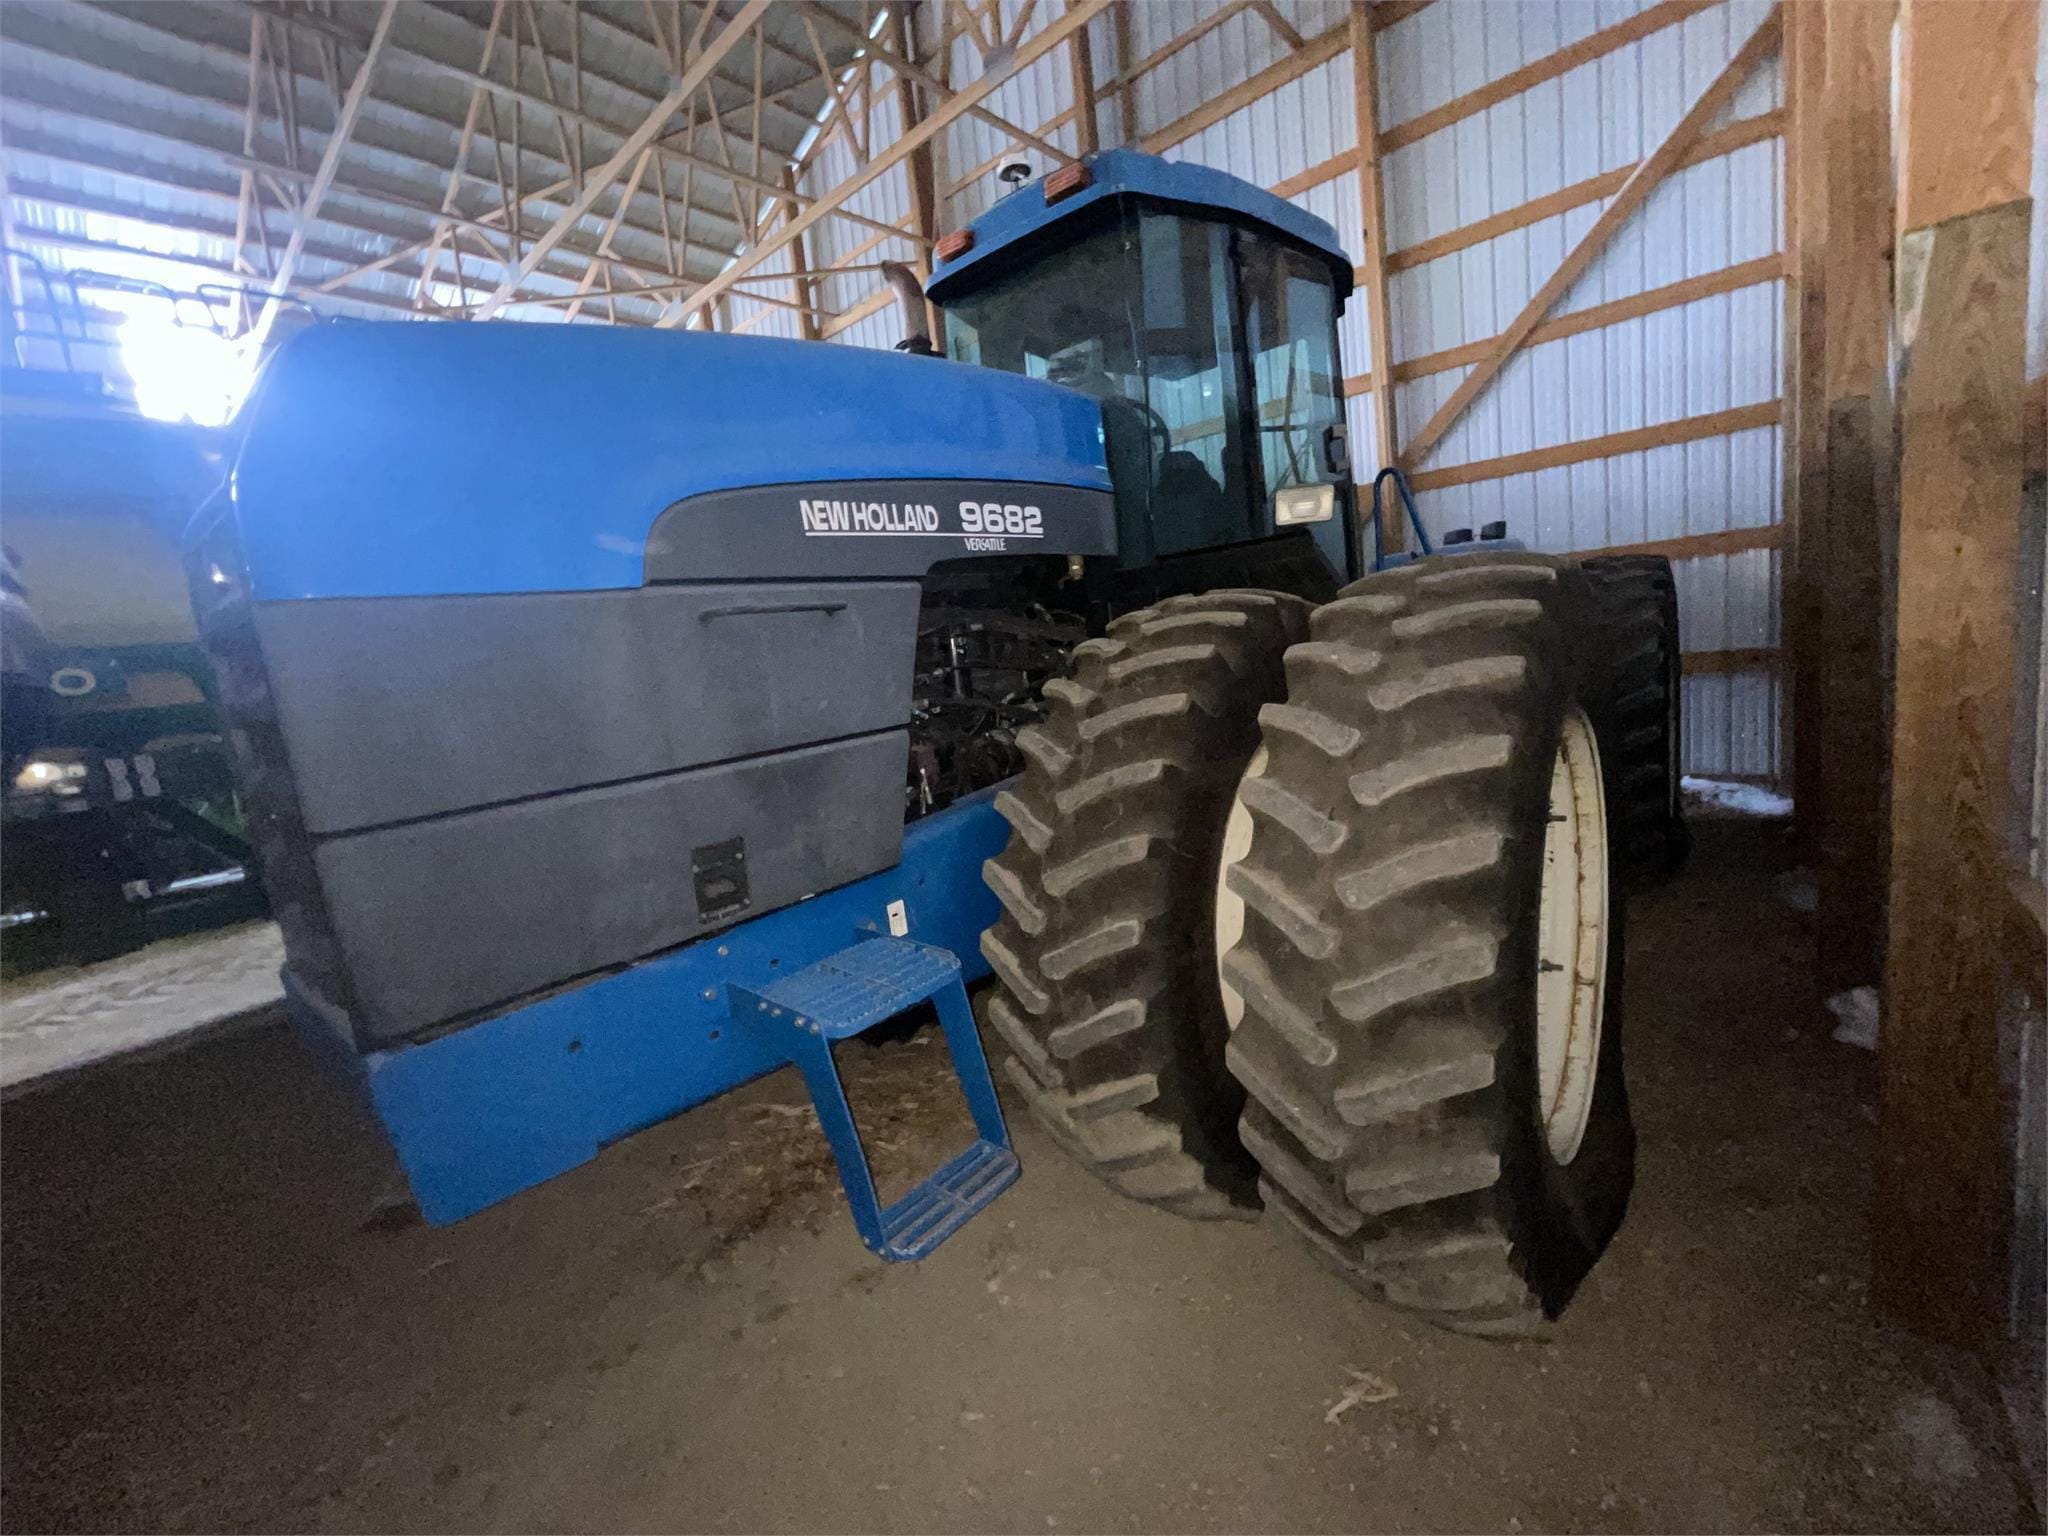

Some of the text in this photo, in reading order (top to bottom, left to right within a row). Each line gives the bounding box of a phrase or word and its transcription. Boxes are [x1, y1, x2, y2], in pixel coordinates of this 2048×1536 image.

[800, 500, 1044, 534] NEW HOLLAND 9682
[964, 537, 1007, 551] VERSATILE
